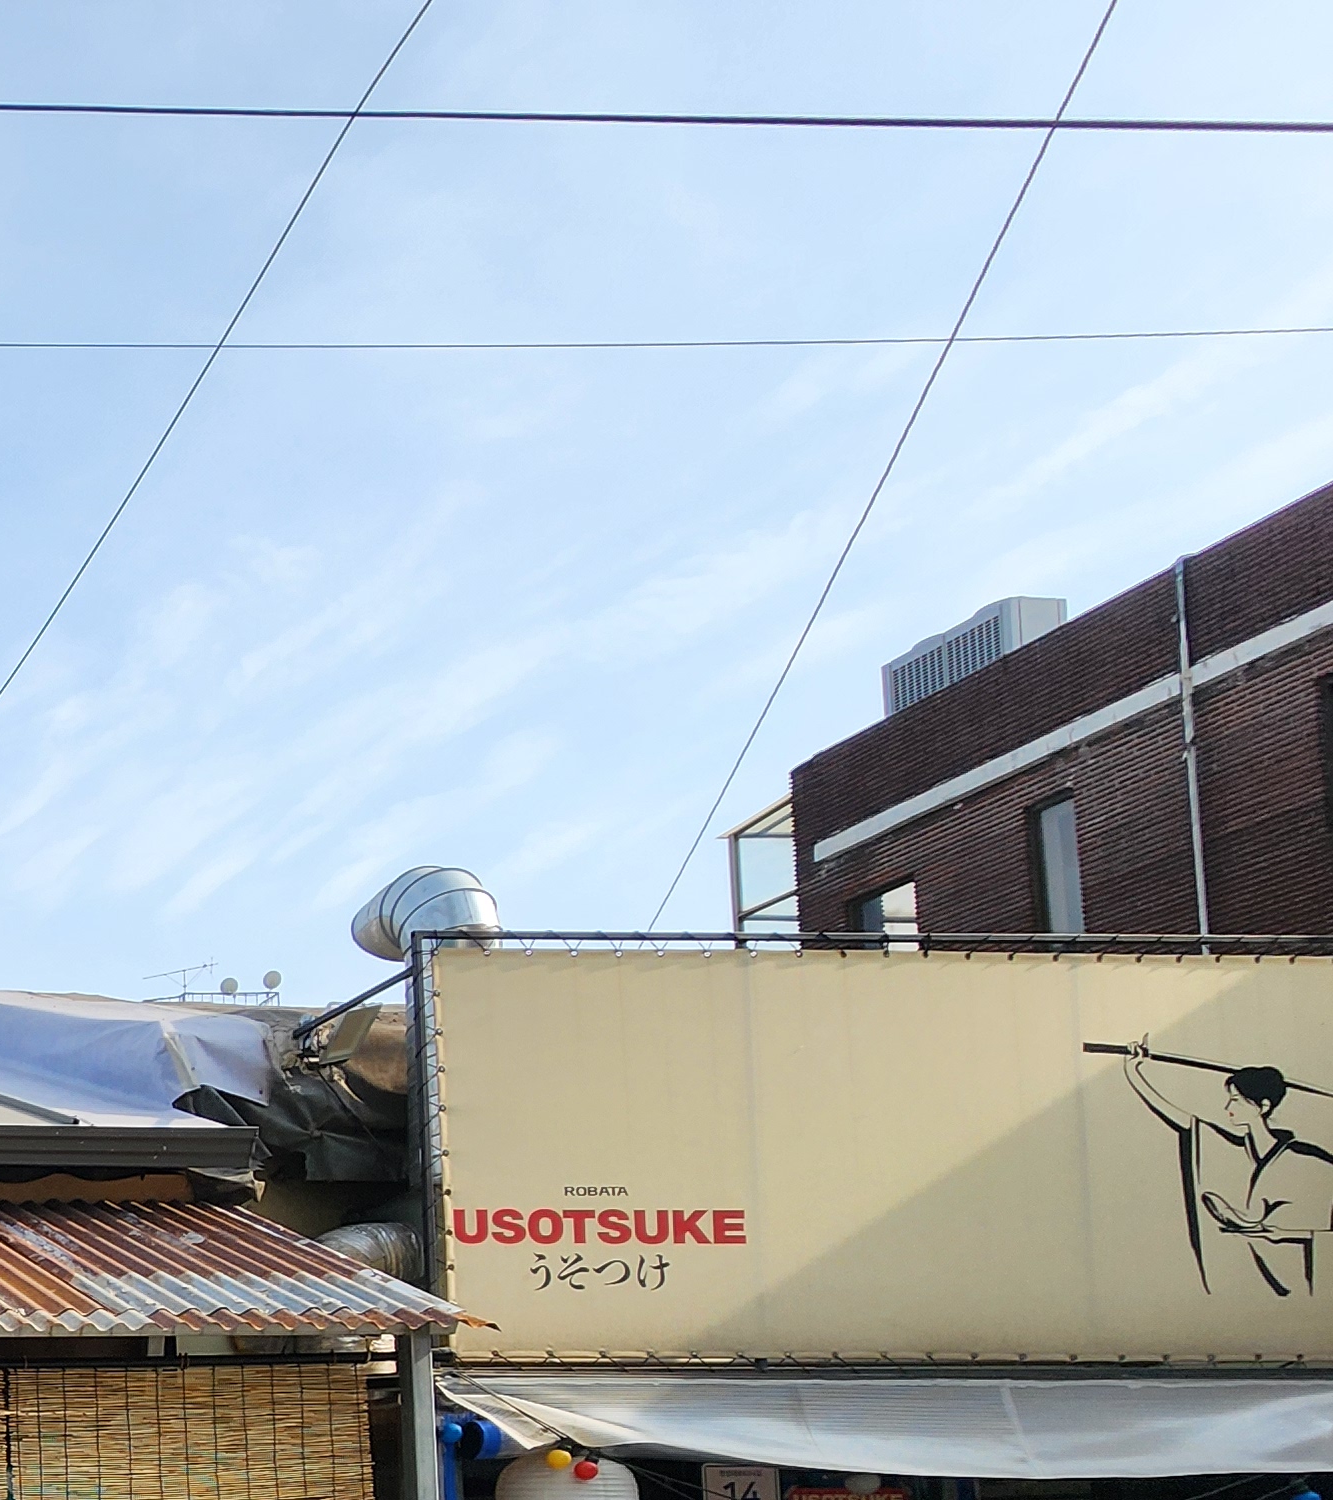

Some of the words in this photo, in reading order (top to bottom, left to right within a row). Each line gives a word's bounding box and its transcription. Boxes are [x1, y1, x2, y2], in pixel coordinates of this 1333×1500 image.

[563, 1185, 629, 1197] ROBATA
[452, 1207, 748, 1245] USOTSUKE
[529, 1252, 671, 1291] うそつけ
